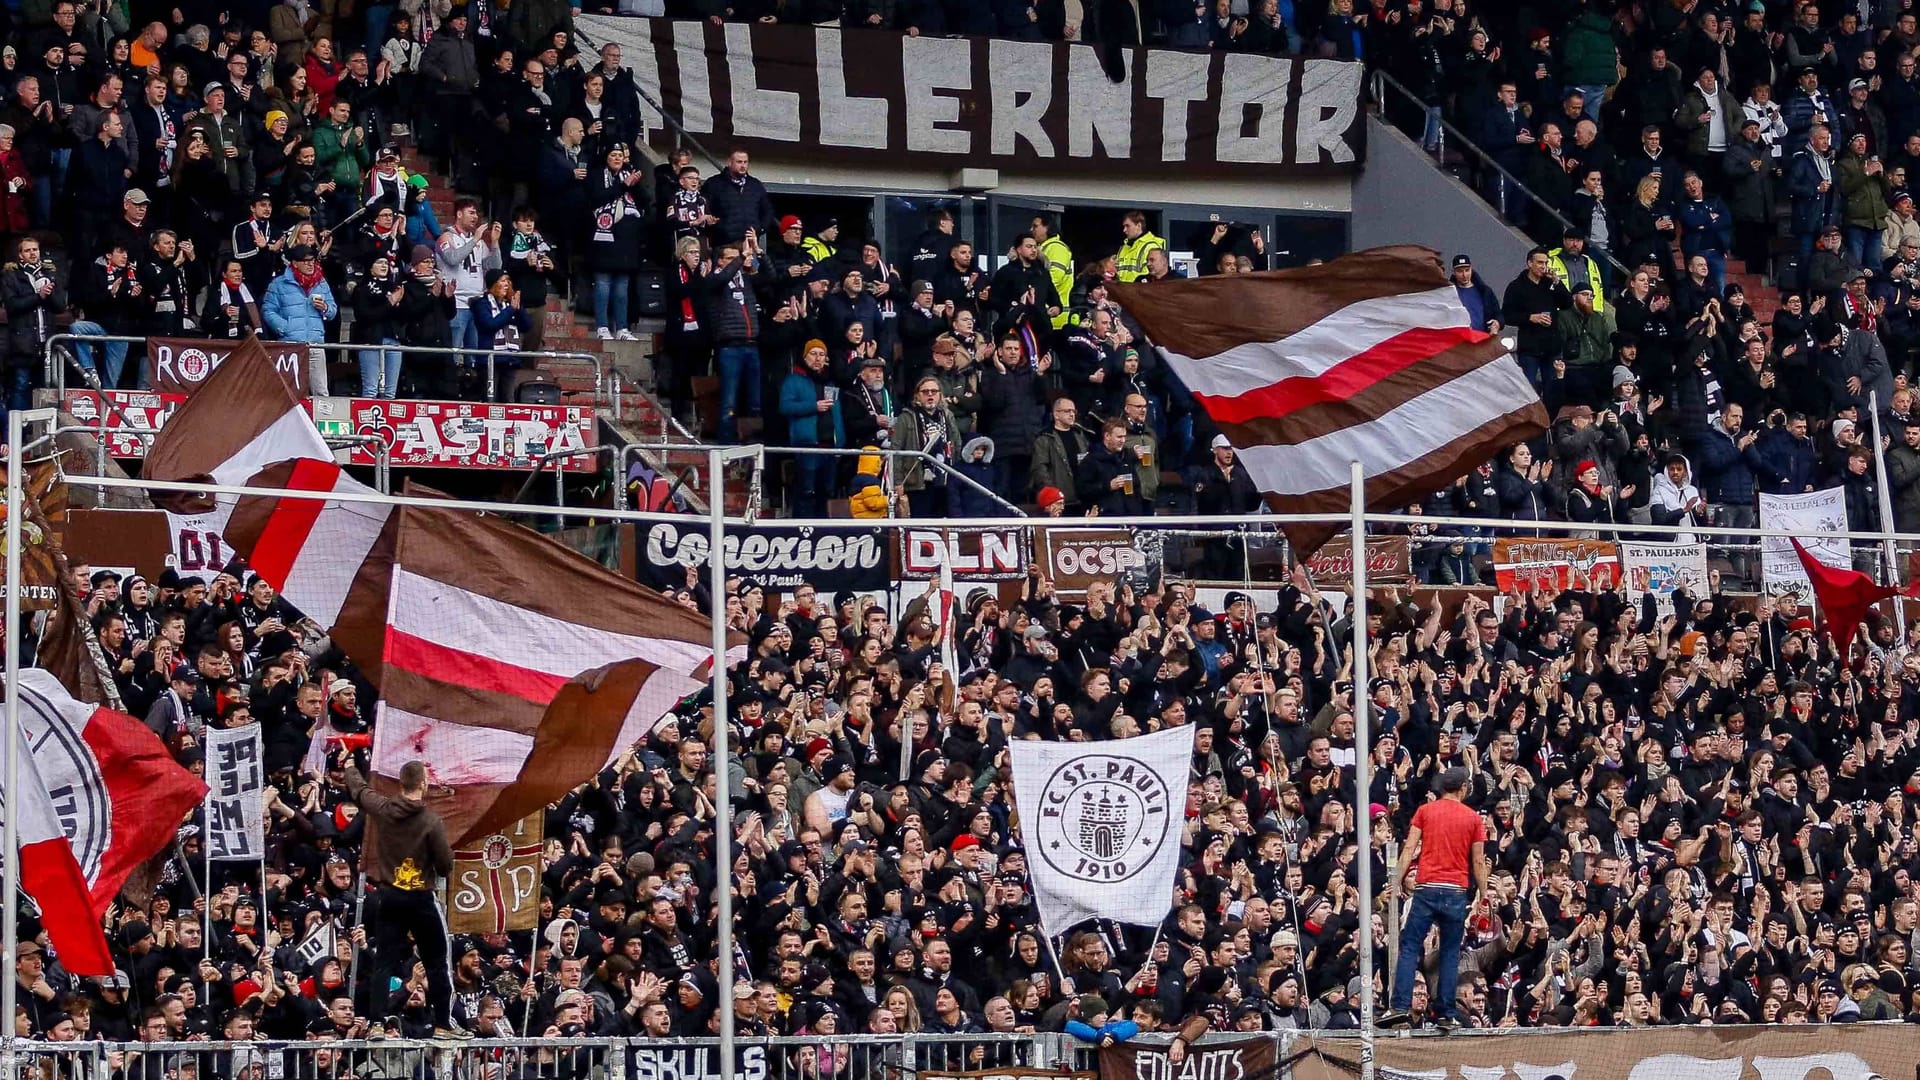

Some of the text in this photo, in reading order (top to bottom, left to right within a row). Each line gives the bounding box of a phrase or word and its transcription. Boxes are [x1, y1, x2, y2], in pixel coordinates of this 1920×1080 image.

[402, 416, 587, 458] ASTRA
[647, 523, 881, 571] Conexion
[906, 531, 1018, 573] DLN
[1056, 546, 1137, 575] OCSP
[1507, 543, 1565, 564] FLYING
[1629, 548, 1700, 557] ST. PAULI-FANS
[768, 574, 804, 587] Pauli
[1043, 761, 1163, 817] FC ST. PAULI
[1074, 857, 1127, 879] 1910
[635, 1046, 767, 1080] SKULS
